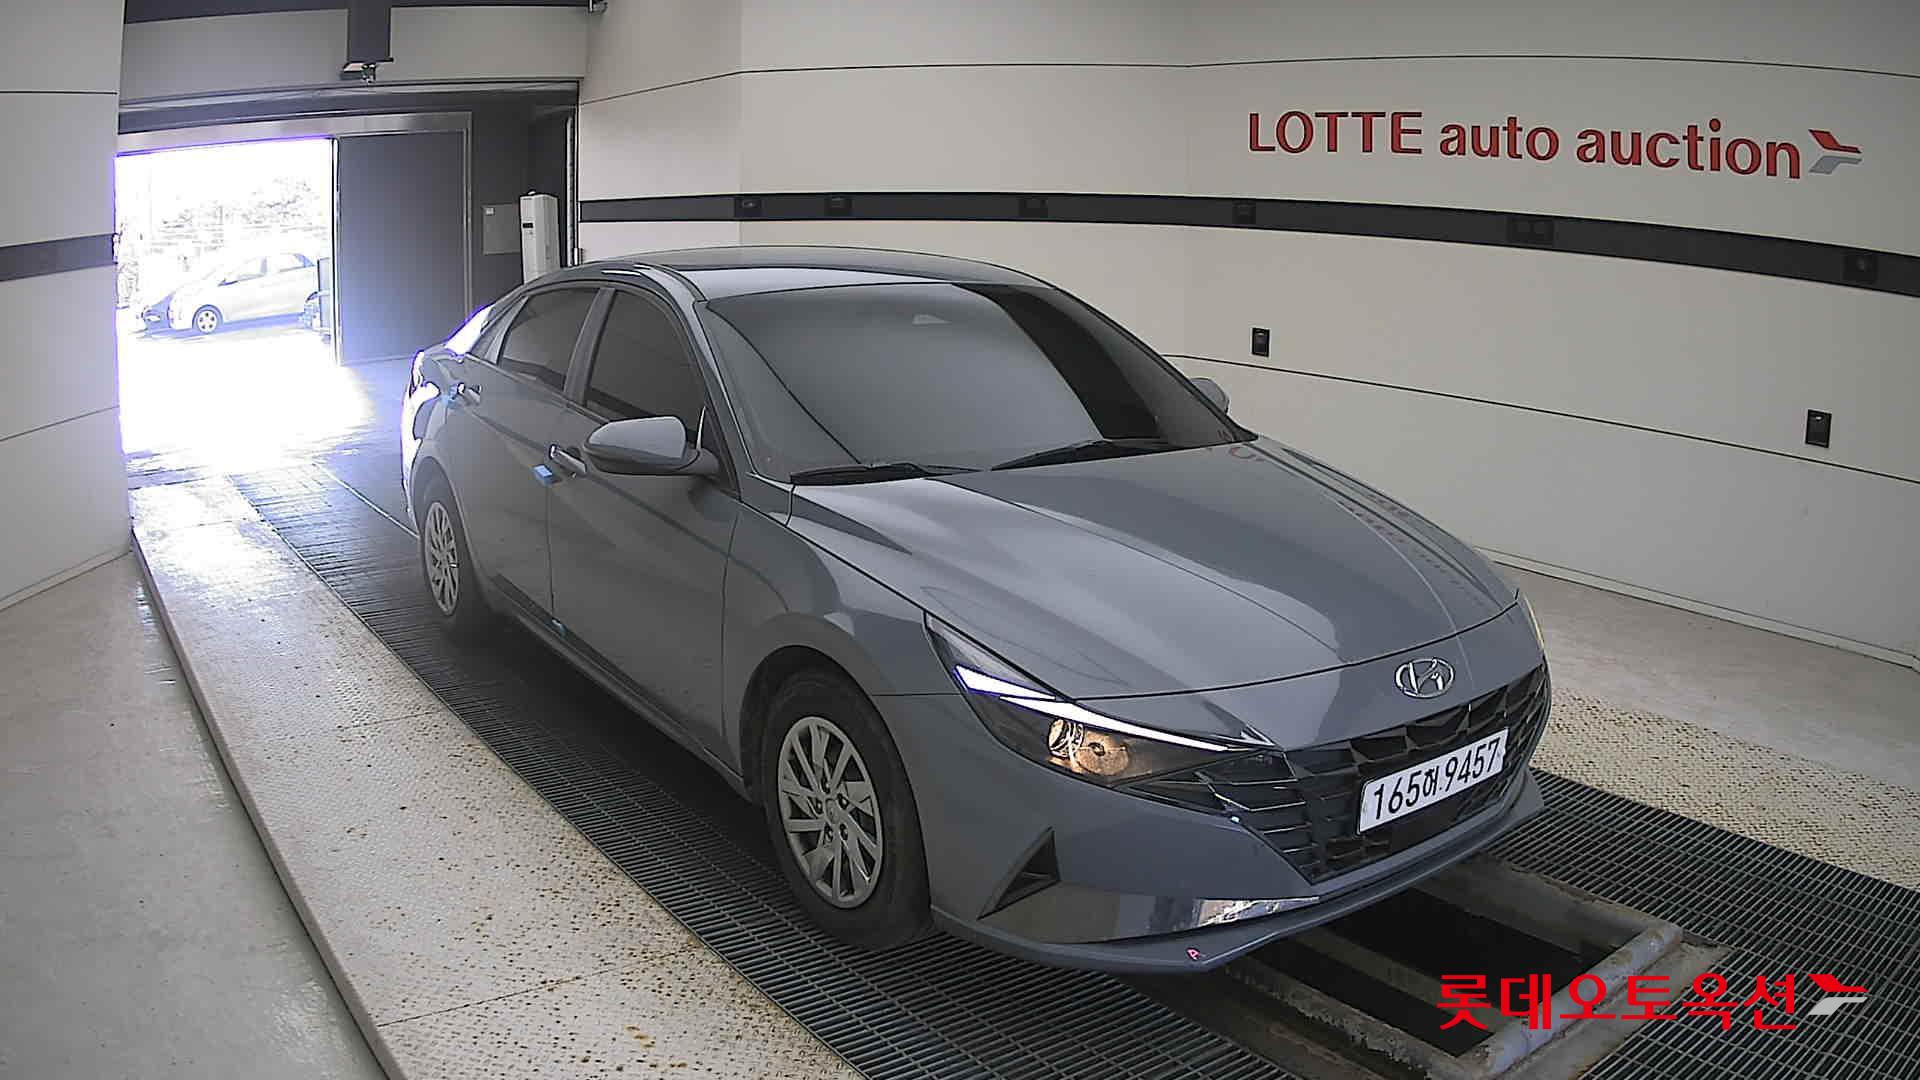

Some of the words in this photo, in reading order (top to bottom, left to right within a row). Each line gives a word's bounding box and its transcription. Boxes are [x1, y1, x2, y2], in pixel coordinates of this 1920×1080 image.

[1248, 111, 1423, 155] LOTTE
[1439, 116, 1561, 162] auto
[1575, 117, 1803, 180] auction
